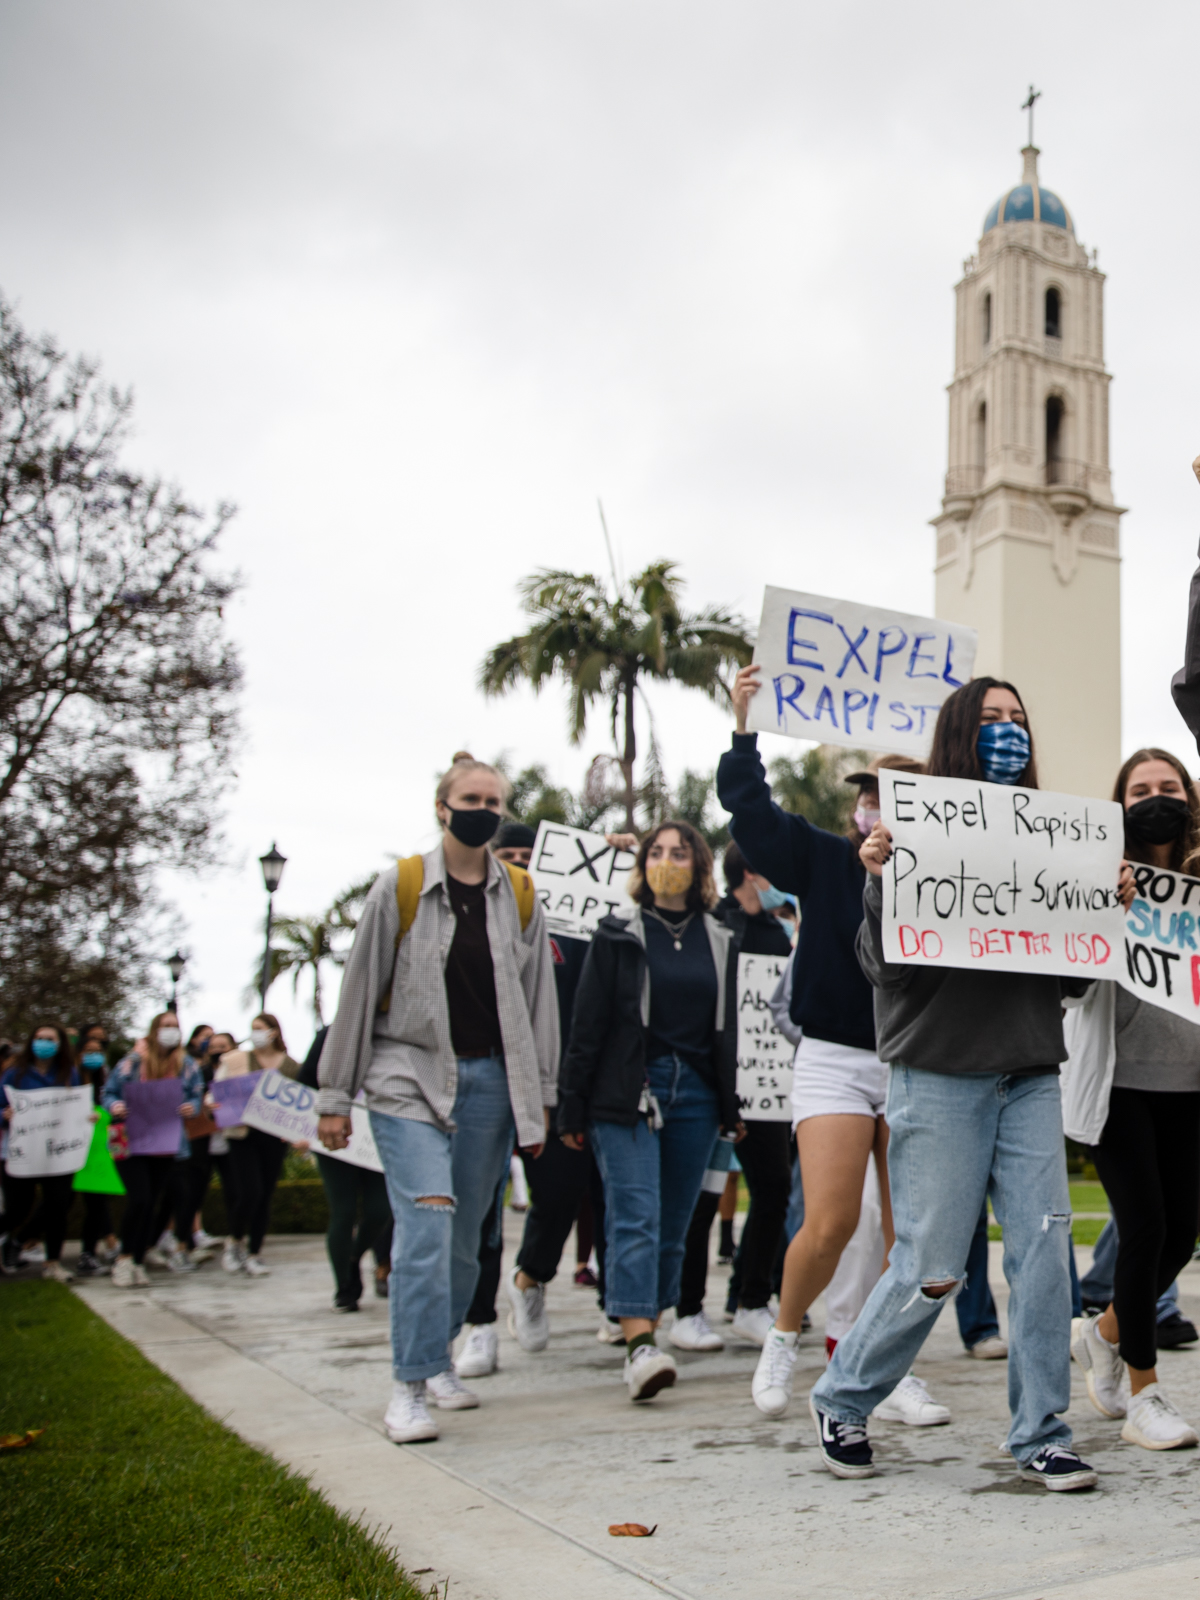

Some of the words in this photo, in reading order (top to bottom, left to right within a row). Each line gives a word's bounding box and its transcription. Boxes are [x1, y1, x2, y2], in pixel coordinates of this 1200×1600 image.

[786, 606, 966, 689] EXPEL
[892, 780, 988, 837] Expel
[1012, 793, 1108, 849] Rapists
[536, 829, 637, 886] EXP
[892, 846, 1023, 920] Protect
[899, 924, 944, 959] DO
[969, 927, 1052, 958] BETTER
[1064, 932, 1111, 965] USD
[261, 1070, 315, 1112] USD
